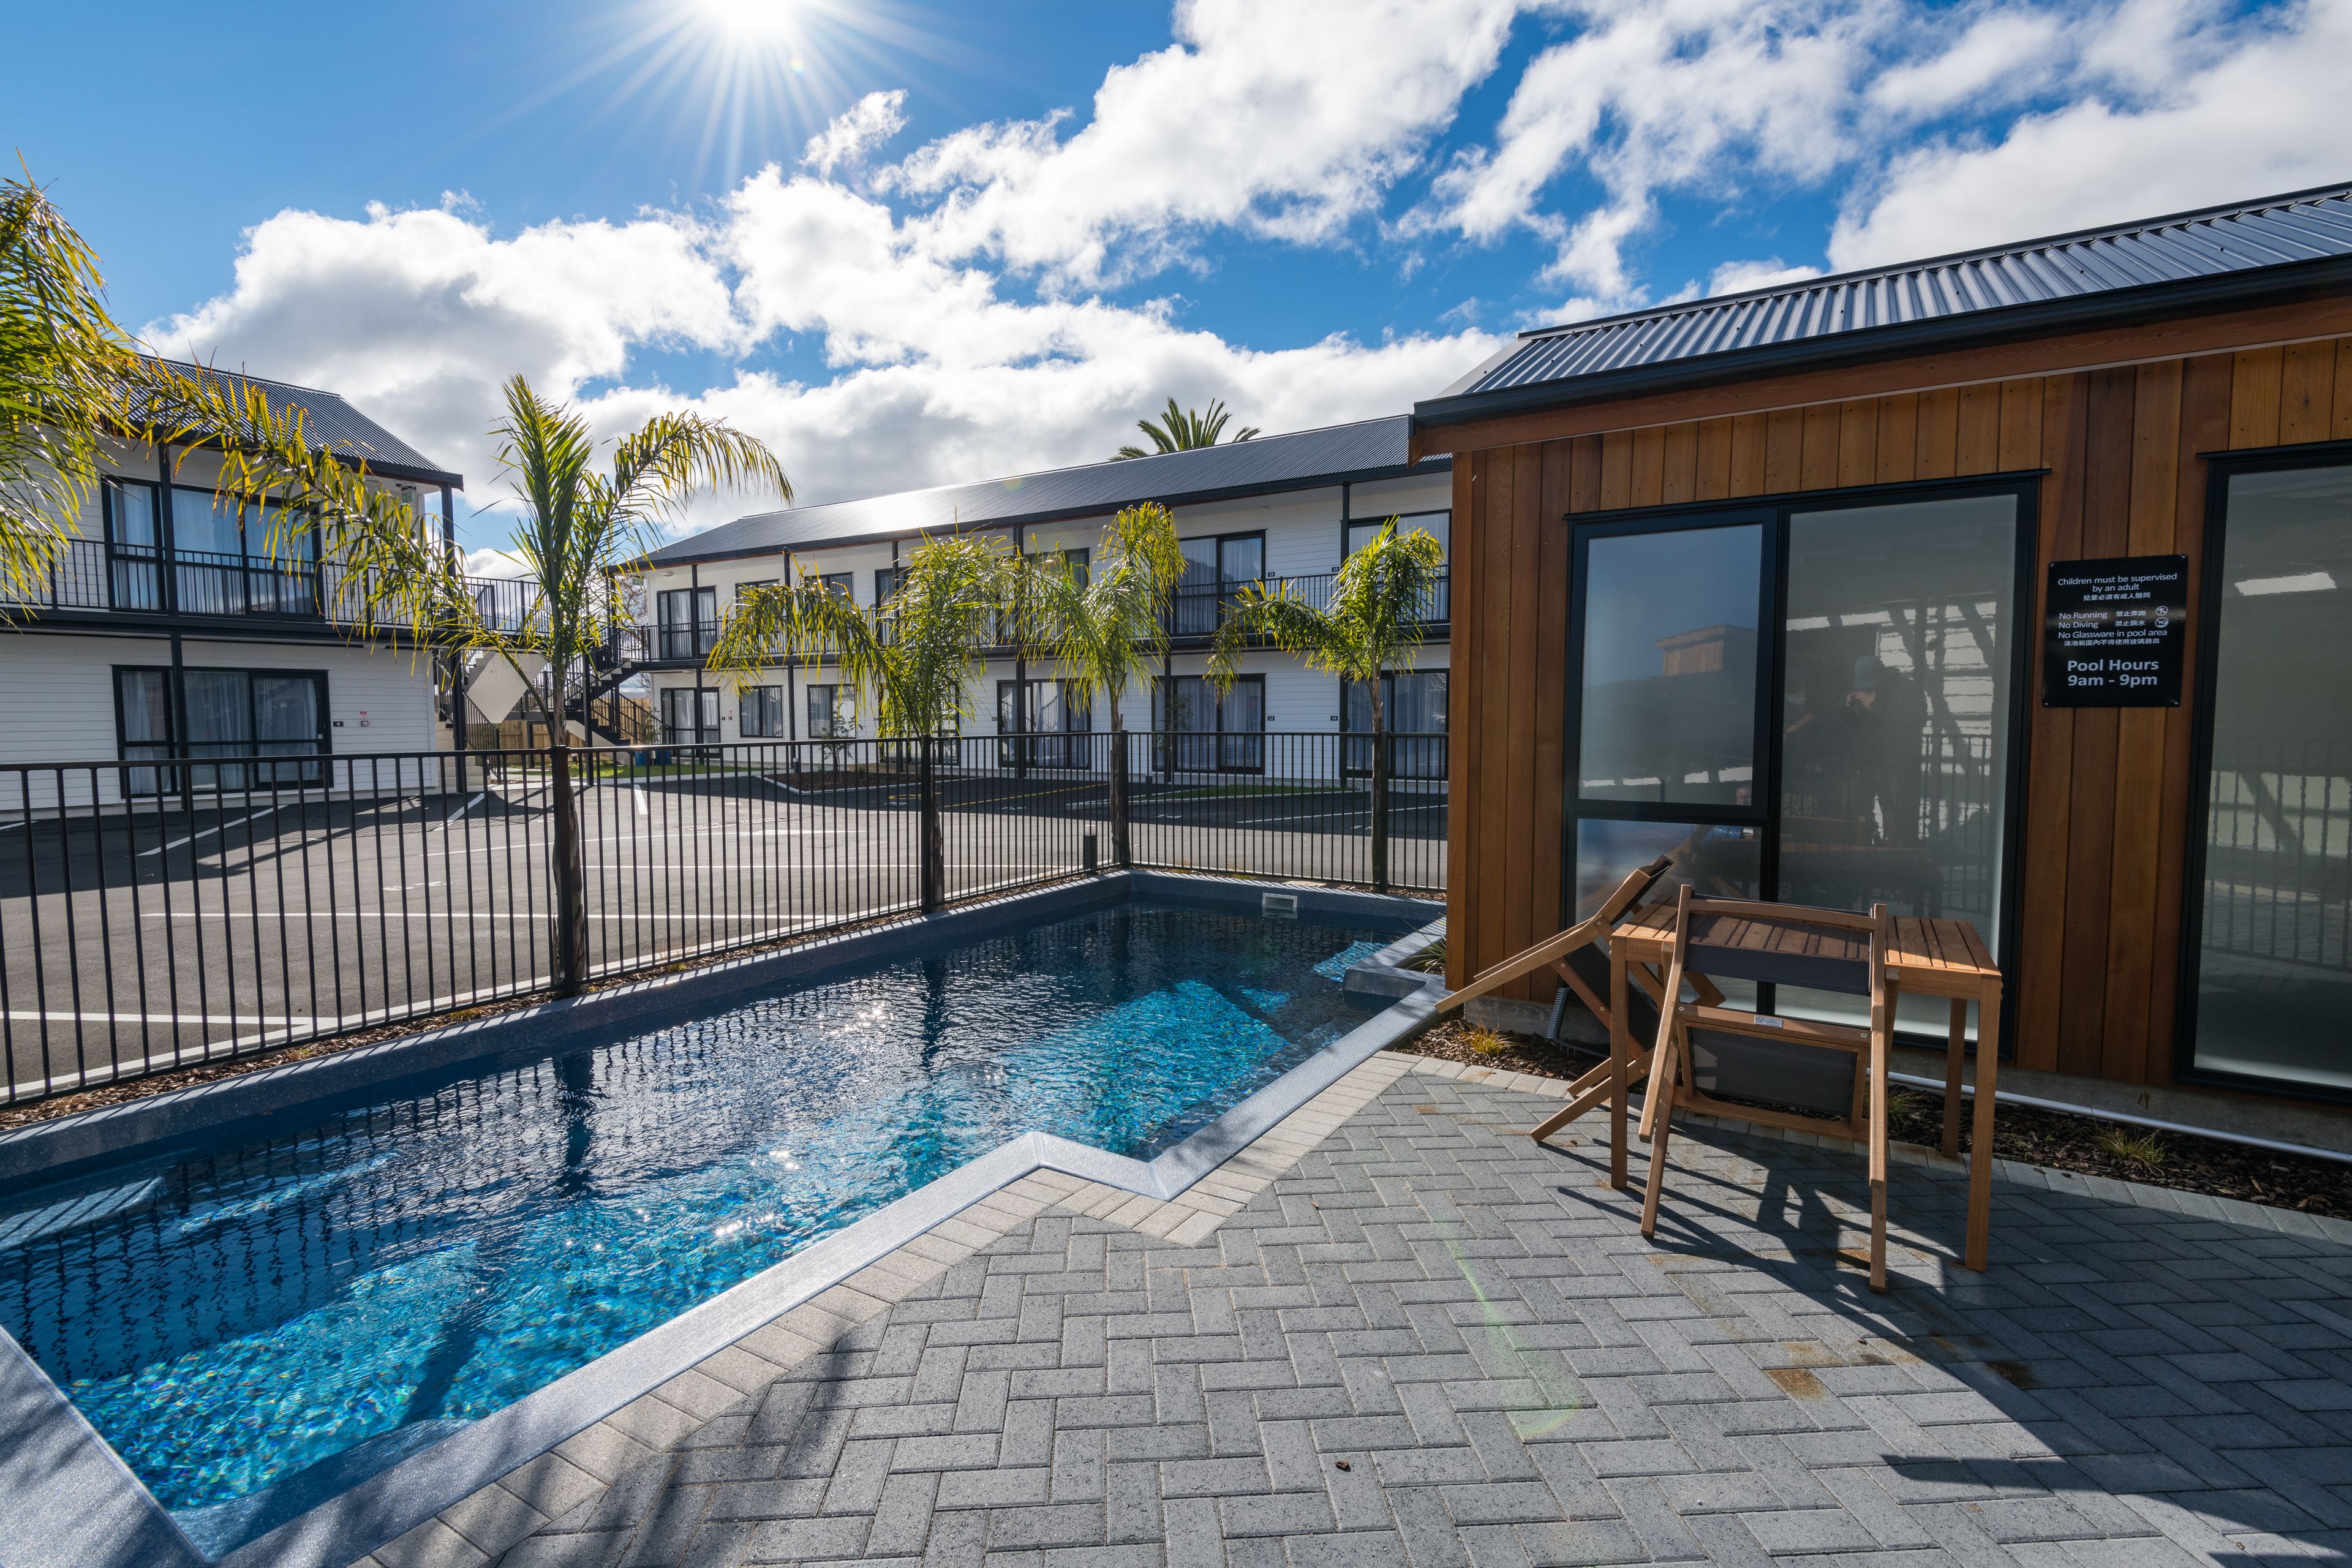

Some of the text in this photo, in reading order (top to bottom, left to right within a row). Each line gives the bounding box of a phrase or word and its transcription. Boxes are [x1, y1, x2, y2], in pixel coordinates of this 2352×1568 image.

[2130, 573, 2177, 582] supervised
[2127, 629, 2146, 638] pool
[2067, 660, 2159, 671] Pool Hours
[2068, 675, 2103, 686] 9am
[2119, 674, 2157, 687] 9pm
